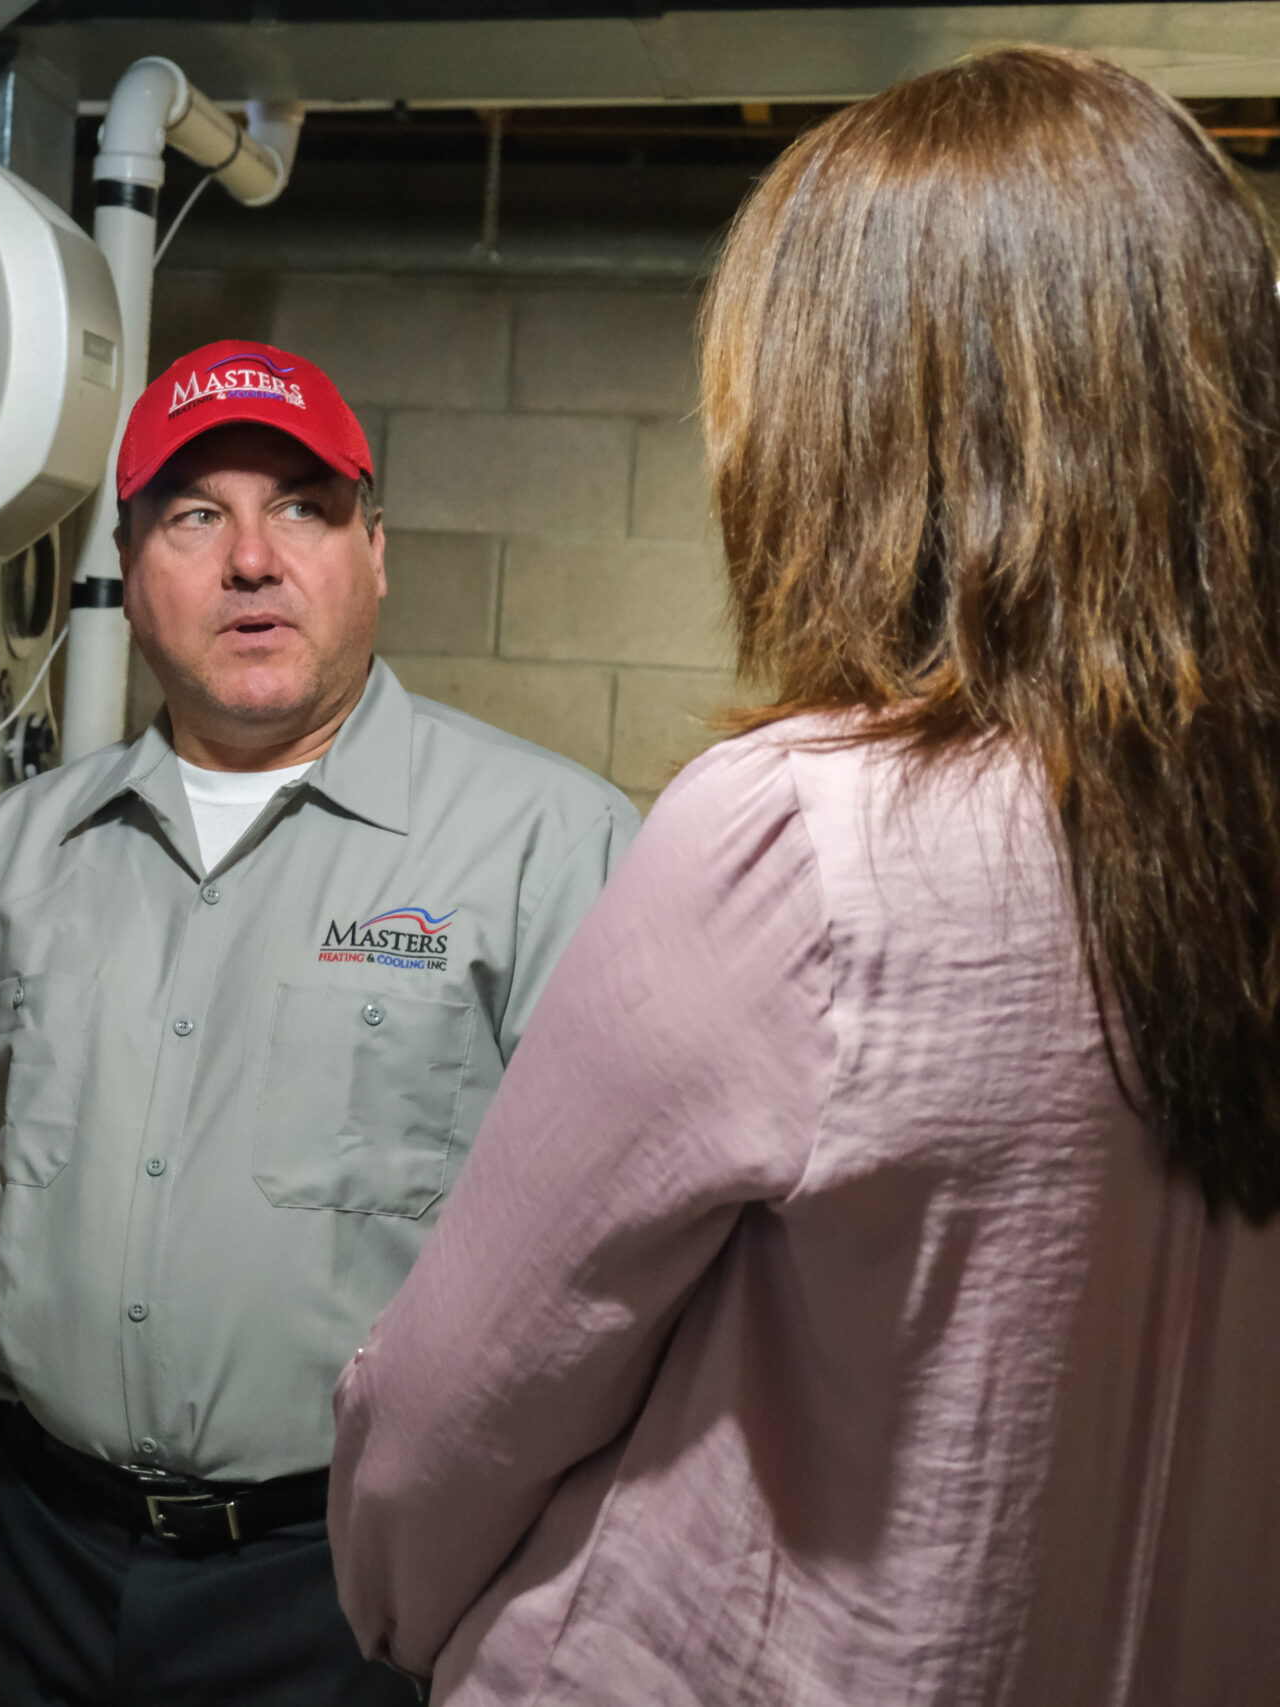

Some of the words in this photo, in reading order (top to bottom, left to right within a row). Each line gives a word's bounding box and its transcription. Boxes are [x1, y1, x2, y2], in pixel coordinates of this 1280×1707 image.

[170, 369, 303, 410] MASTERS
[228, 390, 284, 402] COOLING
[321, 919, 448, 954] MASTERS
[318, 951, 366, 963] HEATING
[366, 953, 375, 963] &
[376, 954, 425, 970] COOLING
[426, 960, 447, 972] INC
